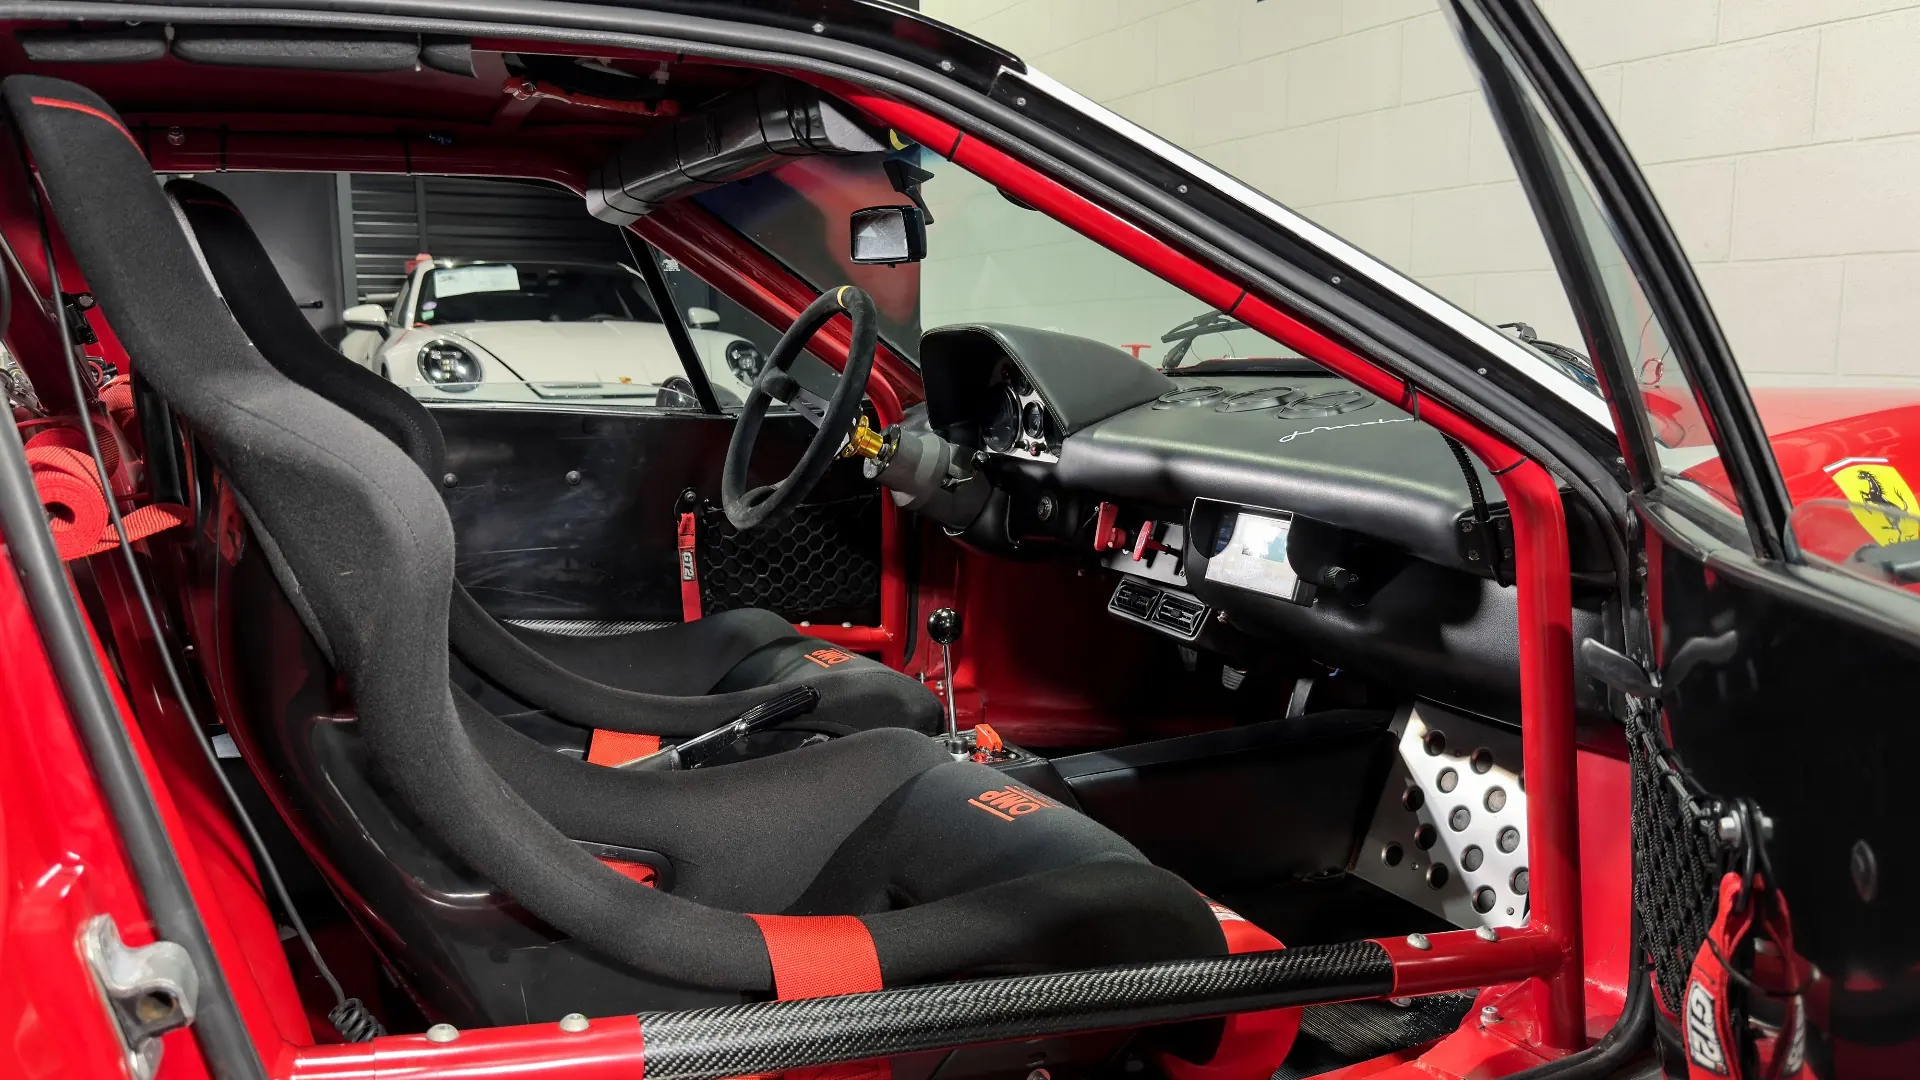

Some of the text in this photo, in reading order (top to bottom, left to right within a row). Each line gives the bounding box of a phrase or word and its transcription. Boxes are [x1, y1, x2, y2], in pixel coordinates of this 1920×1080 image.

[811, 649, 850, 665] OMP
[978, 790, 1041, 816] OMP
[1690, 983, 1726, 1073] GT2i
